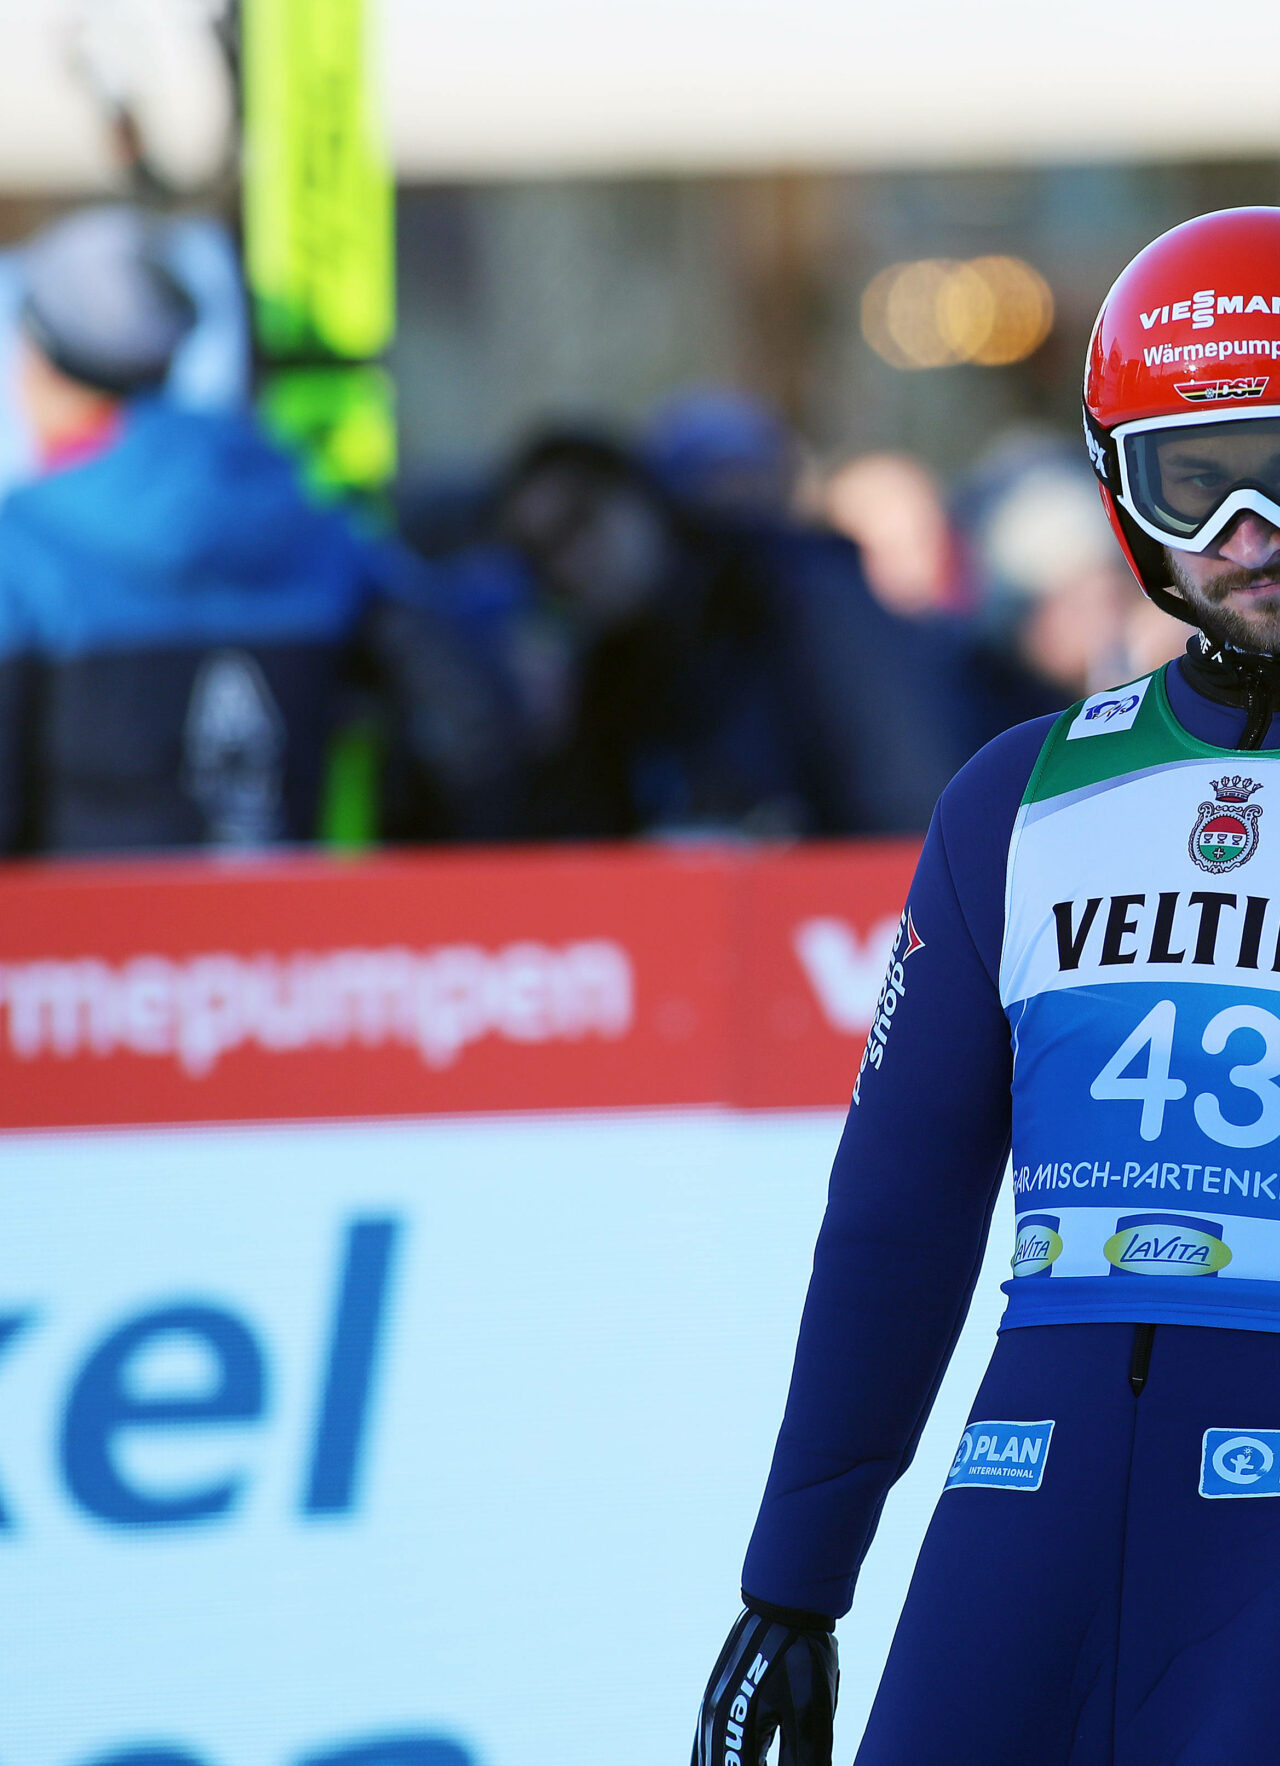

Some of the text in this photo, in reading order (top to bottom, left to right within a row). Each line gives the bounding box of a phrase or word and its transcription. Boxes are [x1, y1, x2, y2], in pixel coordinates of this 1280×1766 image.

[1217, 377, 1269, 400] DSV
[869, 961, 906, 1070] shop
[972, 1435, 1043, 1464] PLAN
[968, 1466, 1034, 1479] INTERNATIONAL
